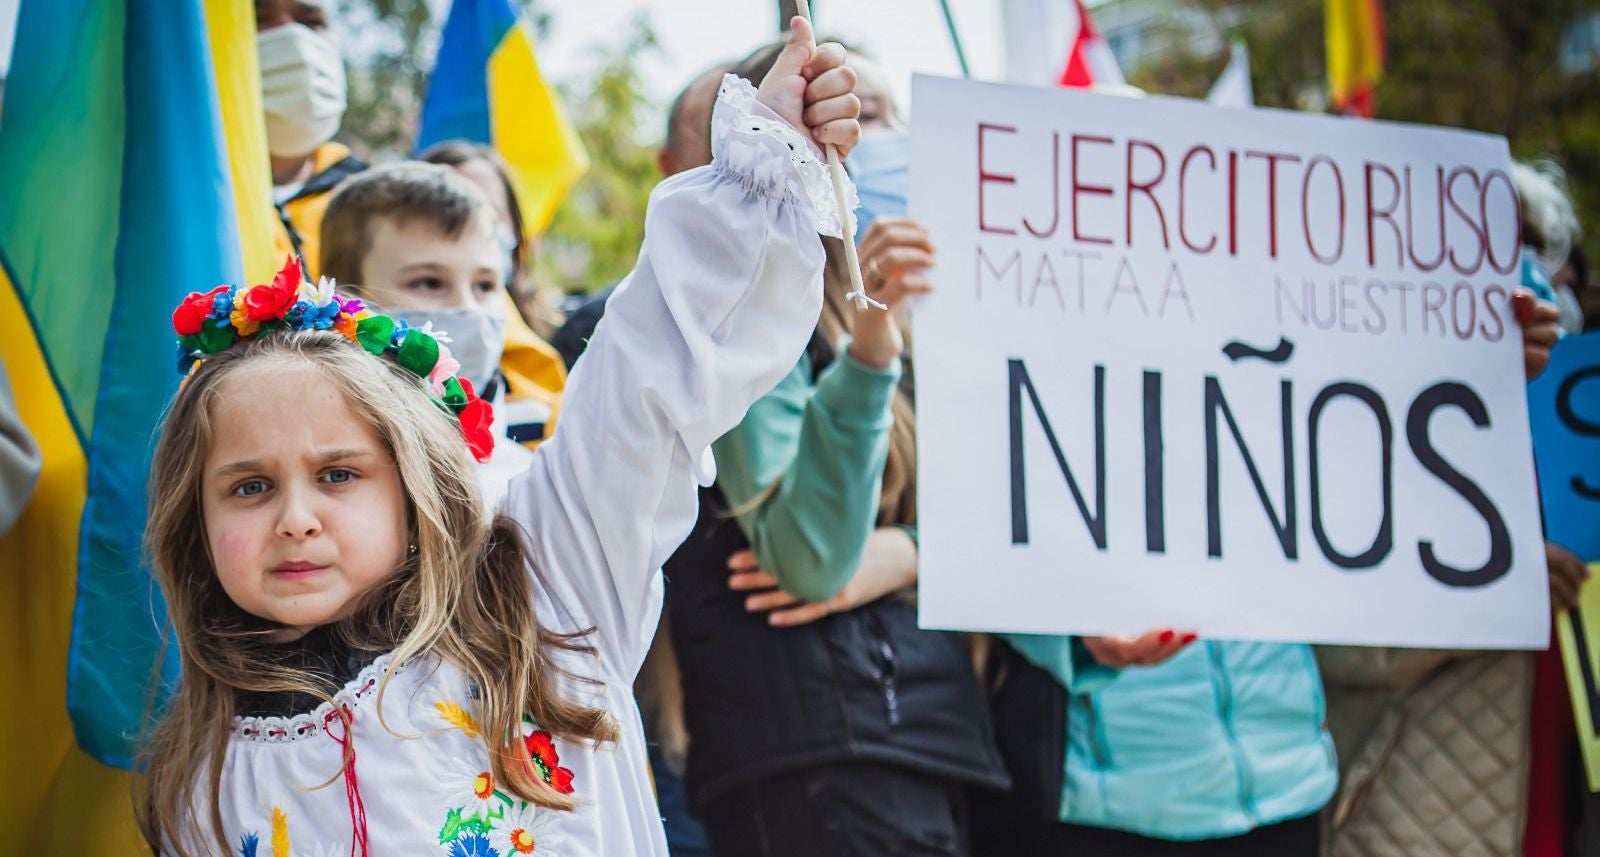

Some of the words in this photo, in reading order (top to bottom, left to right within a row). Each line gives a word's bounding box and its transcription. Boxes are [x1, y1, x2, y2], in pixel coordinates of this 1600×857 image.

[977, 123, 1345, 265] EJERCITO
[1364, 161, 1523, 275] RUSO
[1275, 277, 1506, 342] NUESTROS
[1008, 337, 1512, 587] NIÑOS
